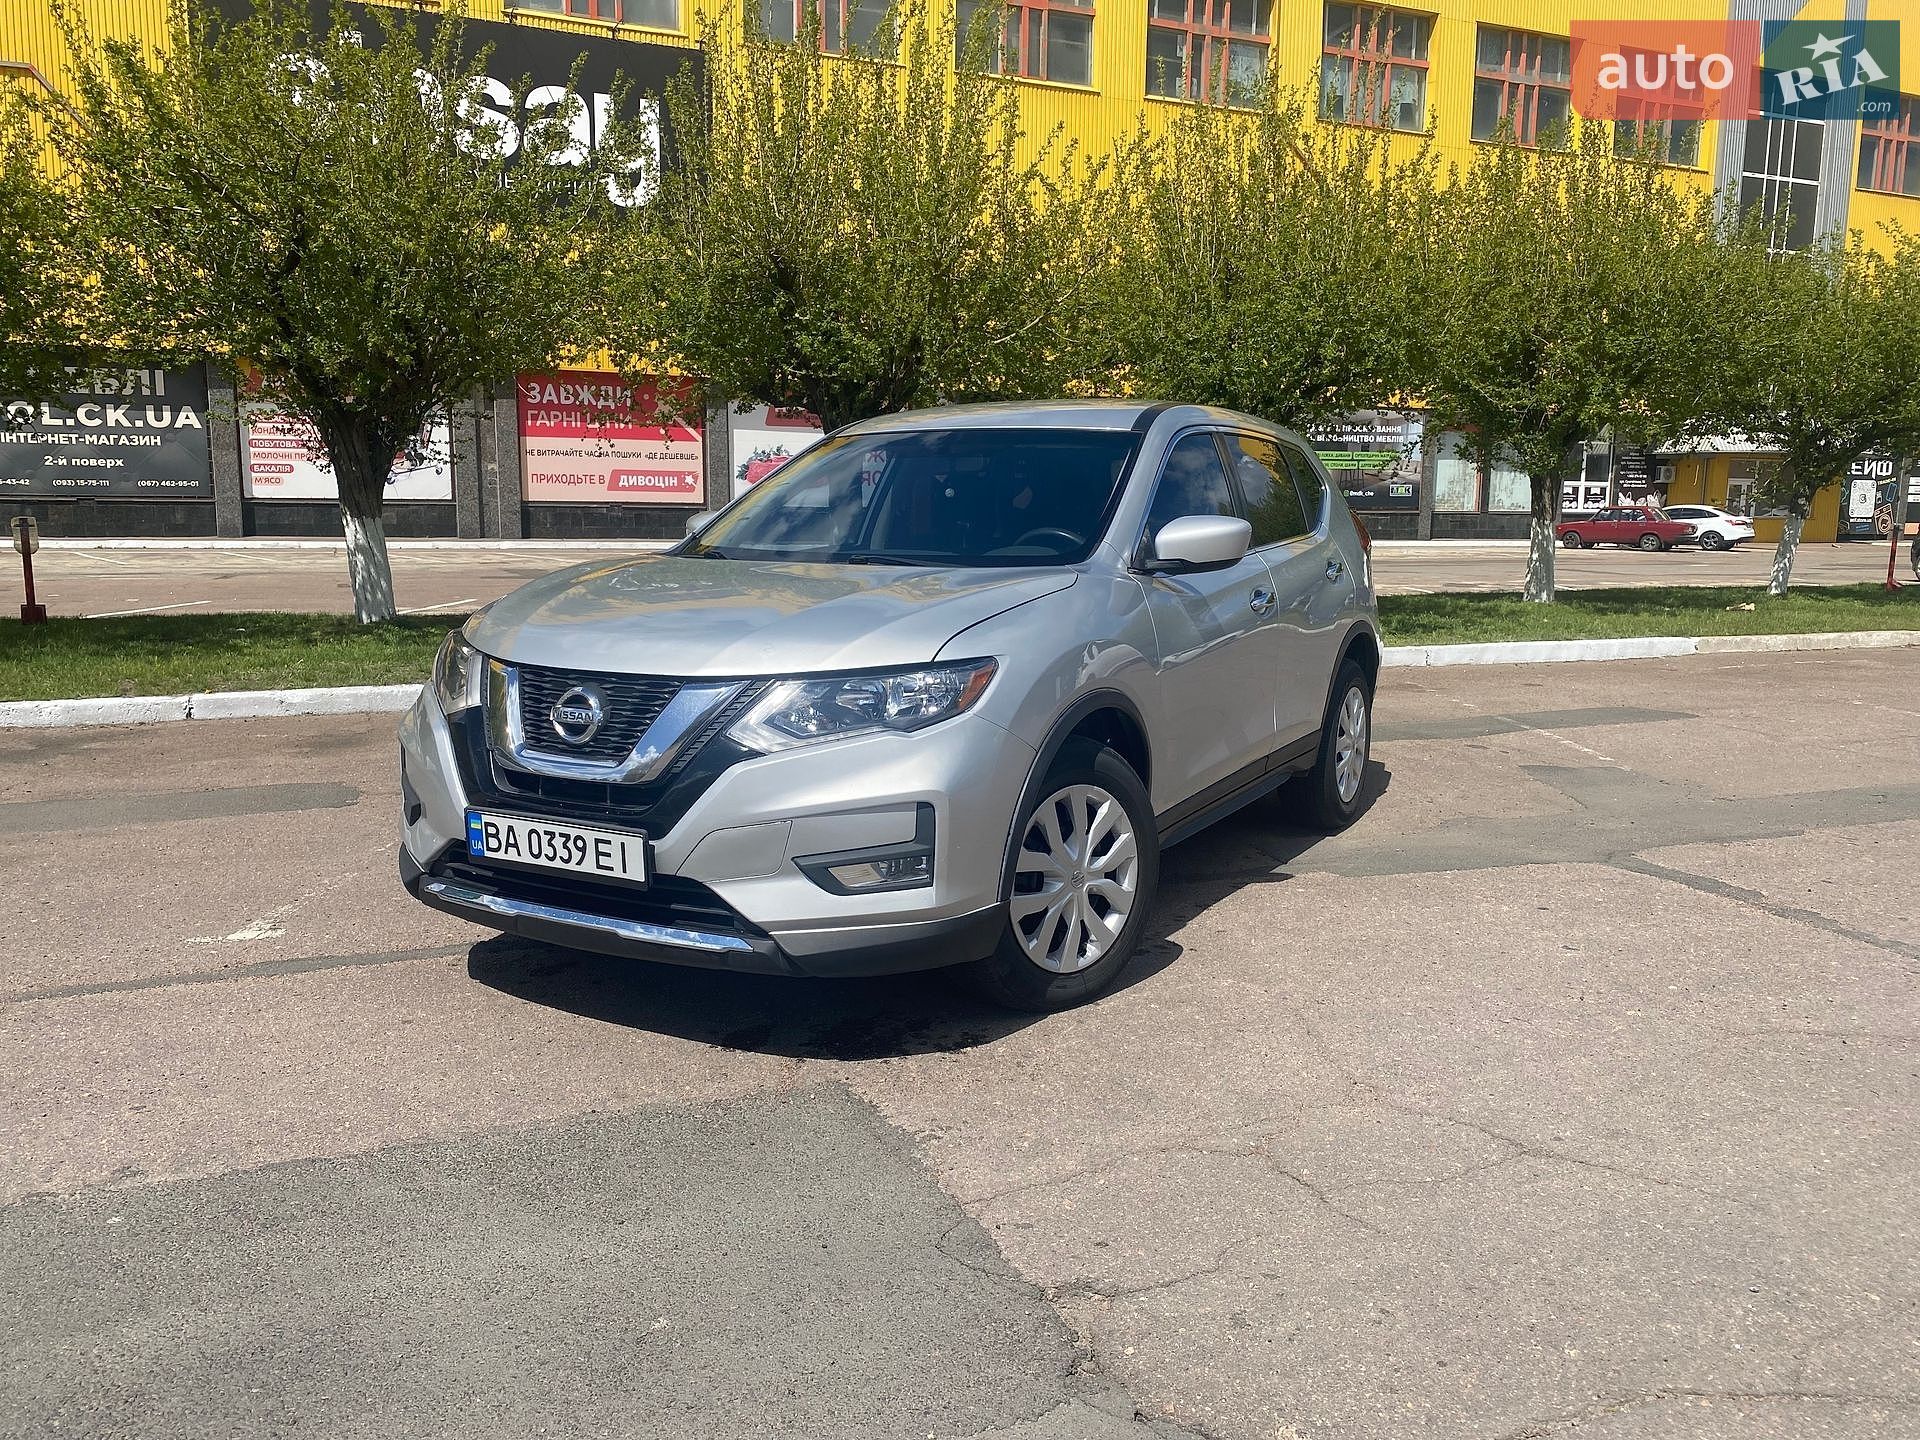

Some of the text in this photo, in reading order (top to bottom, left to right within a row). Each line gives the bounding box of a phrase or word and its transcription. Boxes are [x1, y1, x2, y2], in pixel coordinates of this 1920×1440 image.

[526, 382, 632, 410] ЗАВЖДИ
[0, 400, 202, 429] OL.CK.UA
[526, 409, 581, 429] ГАРНІ
[0, 432, 161, 446] ІНТЕРНЕТ-МАГАЗИН
[252, 440, 298, 449] ПОБУТОВА
[253, 452, 292, 460] МОЛОЧНІ
[525, 449, 536, 457] НЕ
[536, 448, 583, 458] ВИТРАЧАЙТЕ
[610, 451, 642, 460] ПОШУКИ
[43, 455, 124, 469] 2-й поверх
[253, 464, 291, 473] БАКАЛІЯ
[52, 479, 76, 488] (093)
[531, 473, 678, 489] ПРИХОДЬТЕ В ДИВОЦІН
[554, 709, 594, 722] NISSAN
[471, 839, 483, 852] UA
[483, 821, 627, 875] BA 0339 EI
